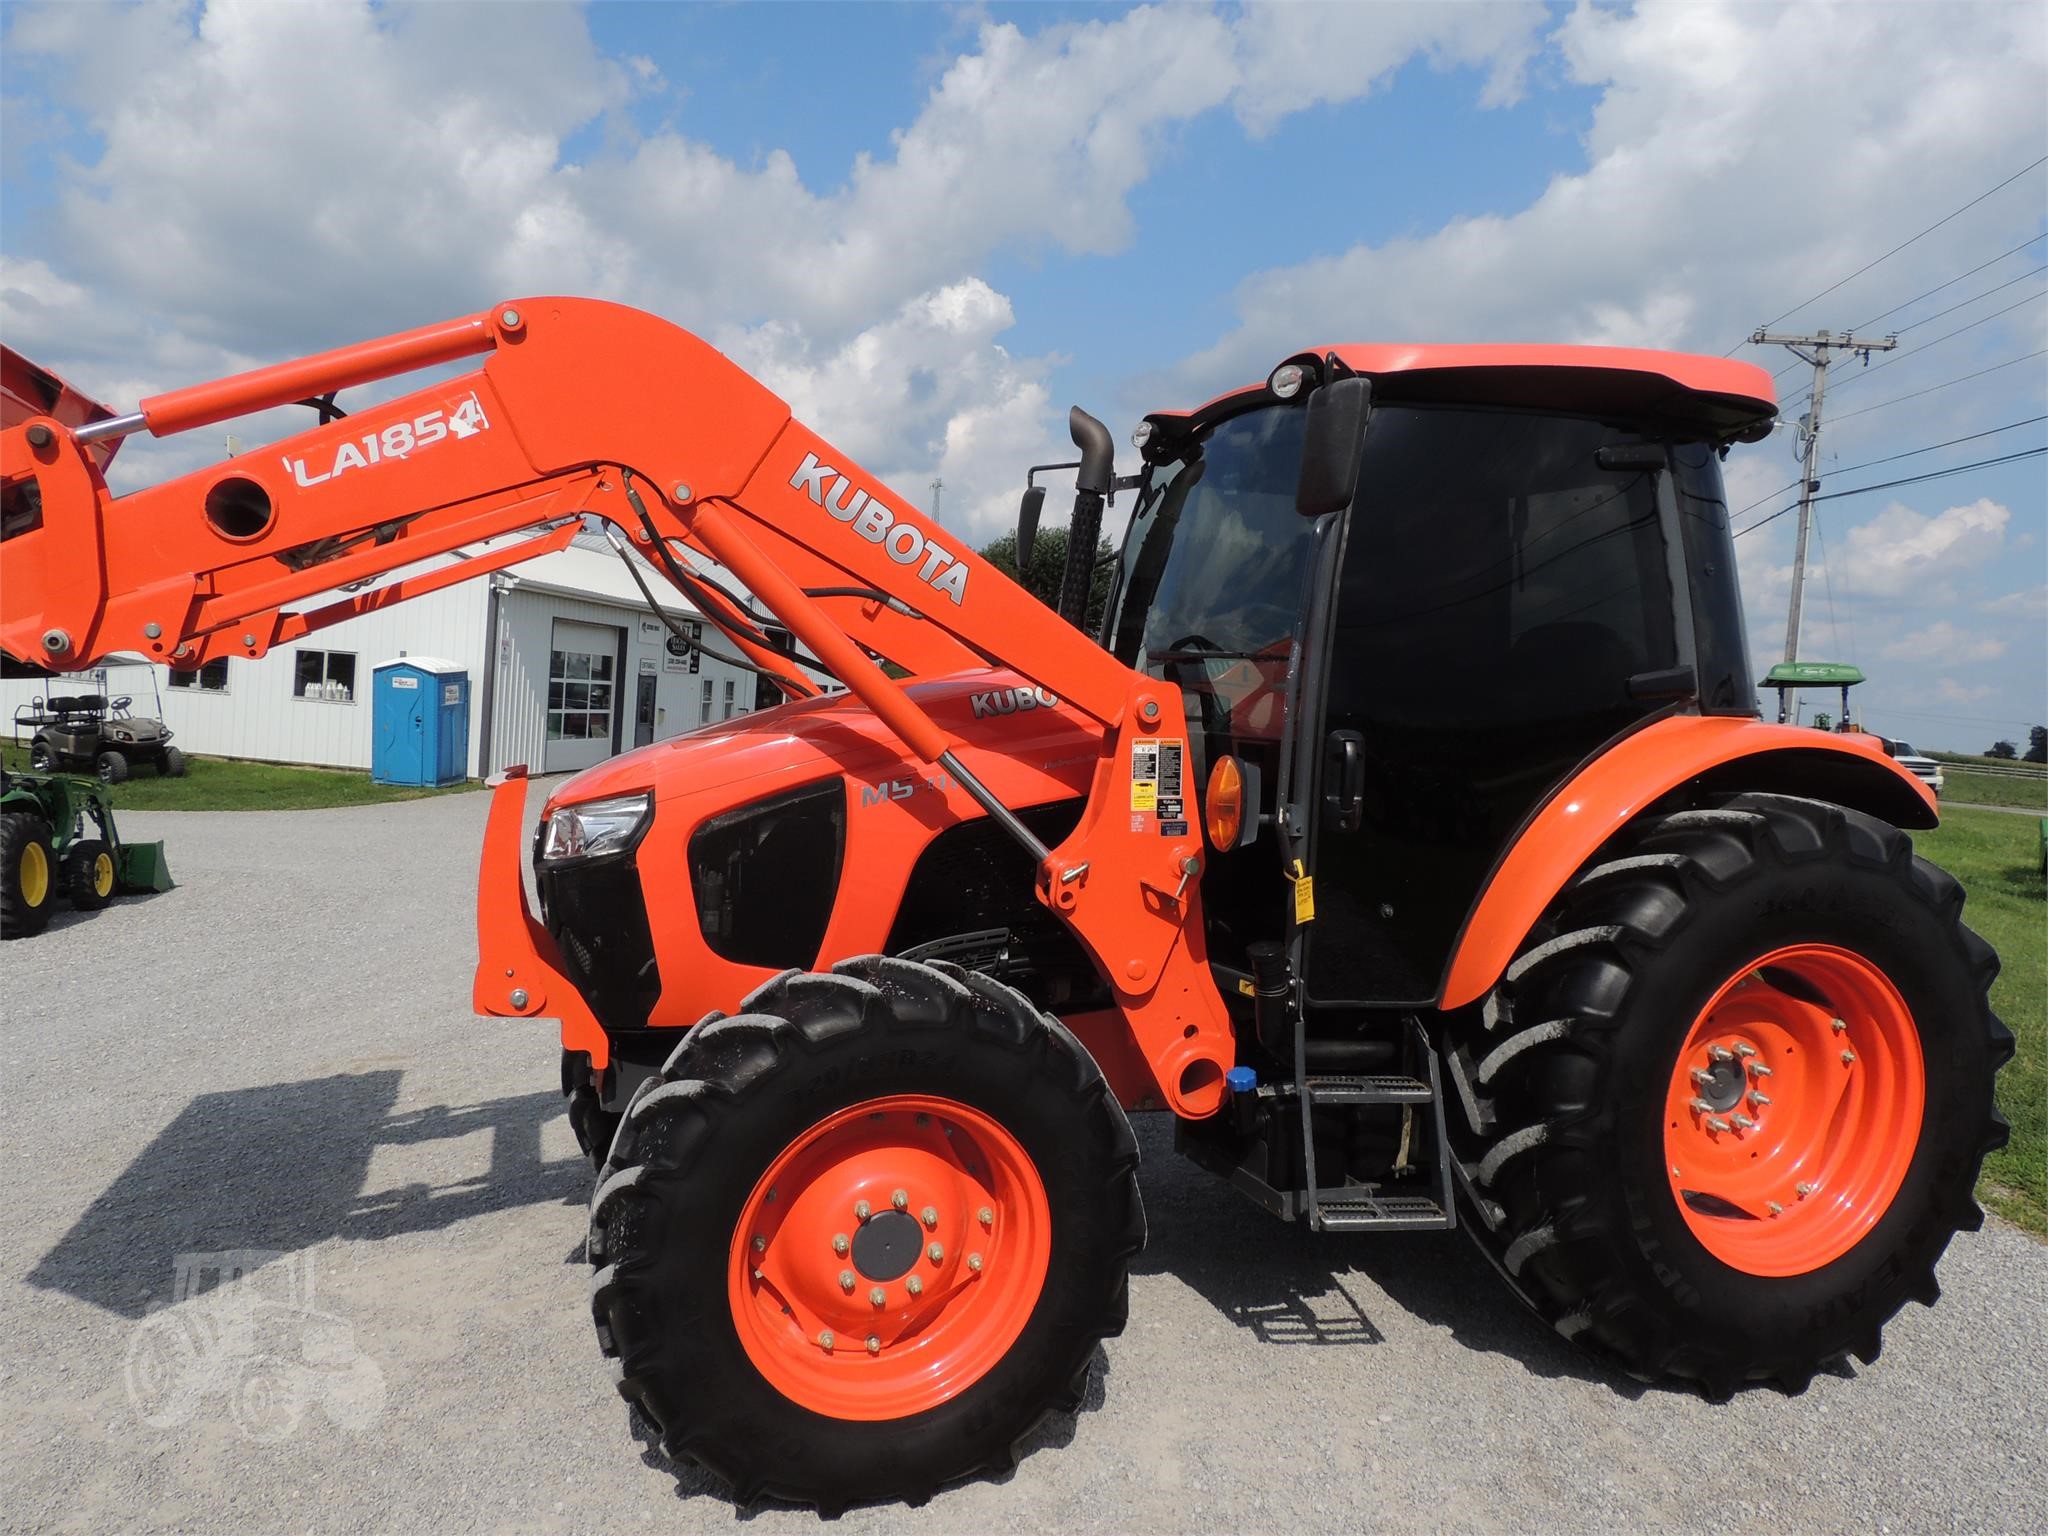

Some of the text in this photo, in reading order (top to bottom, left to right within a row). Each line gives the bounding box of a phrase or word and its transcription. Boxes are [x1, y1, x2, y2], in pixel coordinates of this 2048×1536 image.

[293, 398, 482, 488] LA1854
[788, 450, 970, 607] KUBOTA
[970, 686, 1059, 720] KUBO
